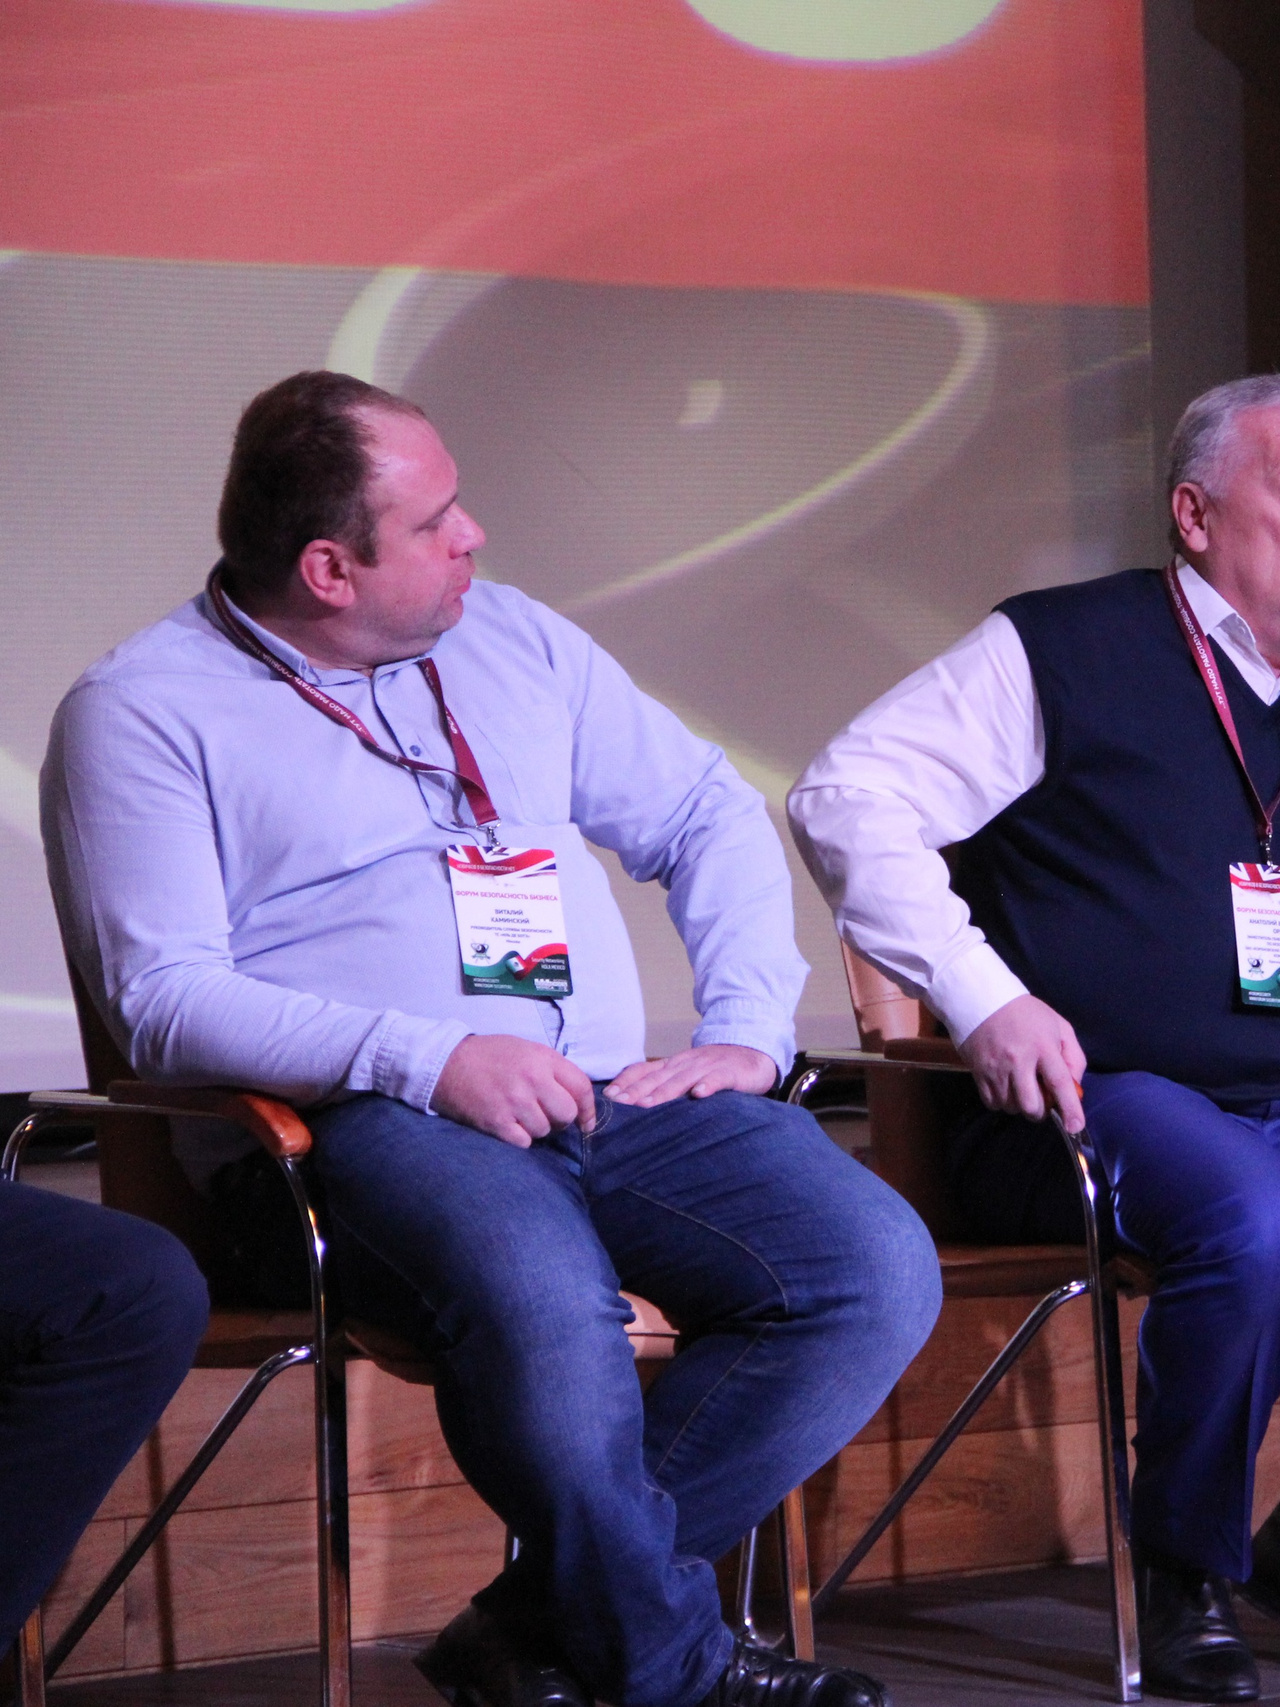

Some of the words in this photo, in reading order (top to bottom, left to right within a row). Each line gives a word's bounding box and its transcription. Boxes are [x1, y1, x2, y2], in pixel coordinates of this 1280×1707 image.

[1193, 633, 1211, 668] РАБОТАТЬ
[294, 676, 330, 704] РАБОТАТЬ
[1207, 668, 1219, 690] НАДО
[329, 703, 351, 719] НАДО
[480, 892, 528, 900] БЕЗОПАСНОСТЬ
